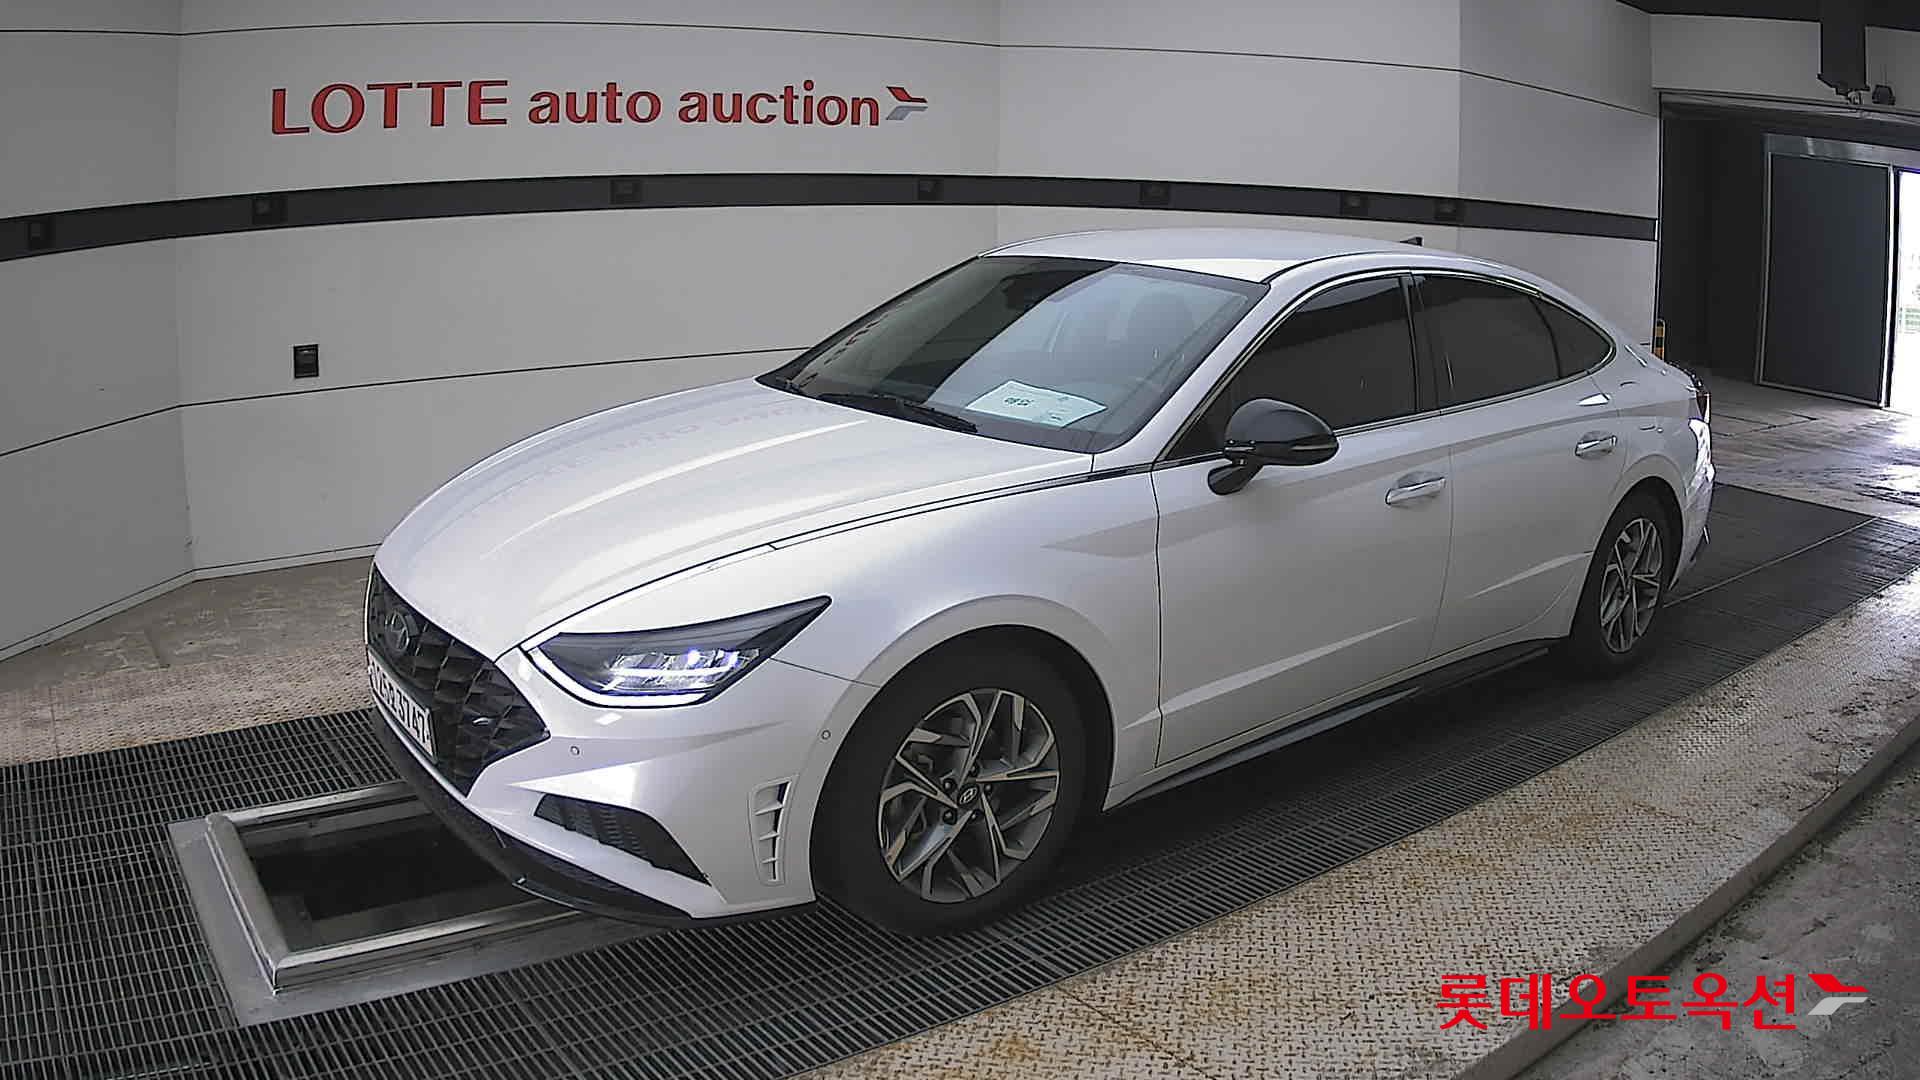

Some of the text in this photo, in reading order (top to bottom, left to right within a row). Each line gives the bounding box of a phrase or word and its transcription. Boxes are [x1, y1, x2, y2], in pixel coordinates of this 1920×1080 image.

[271, 80, 880, 135] LOTTE auto auction
